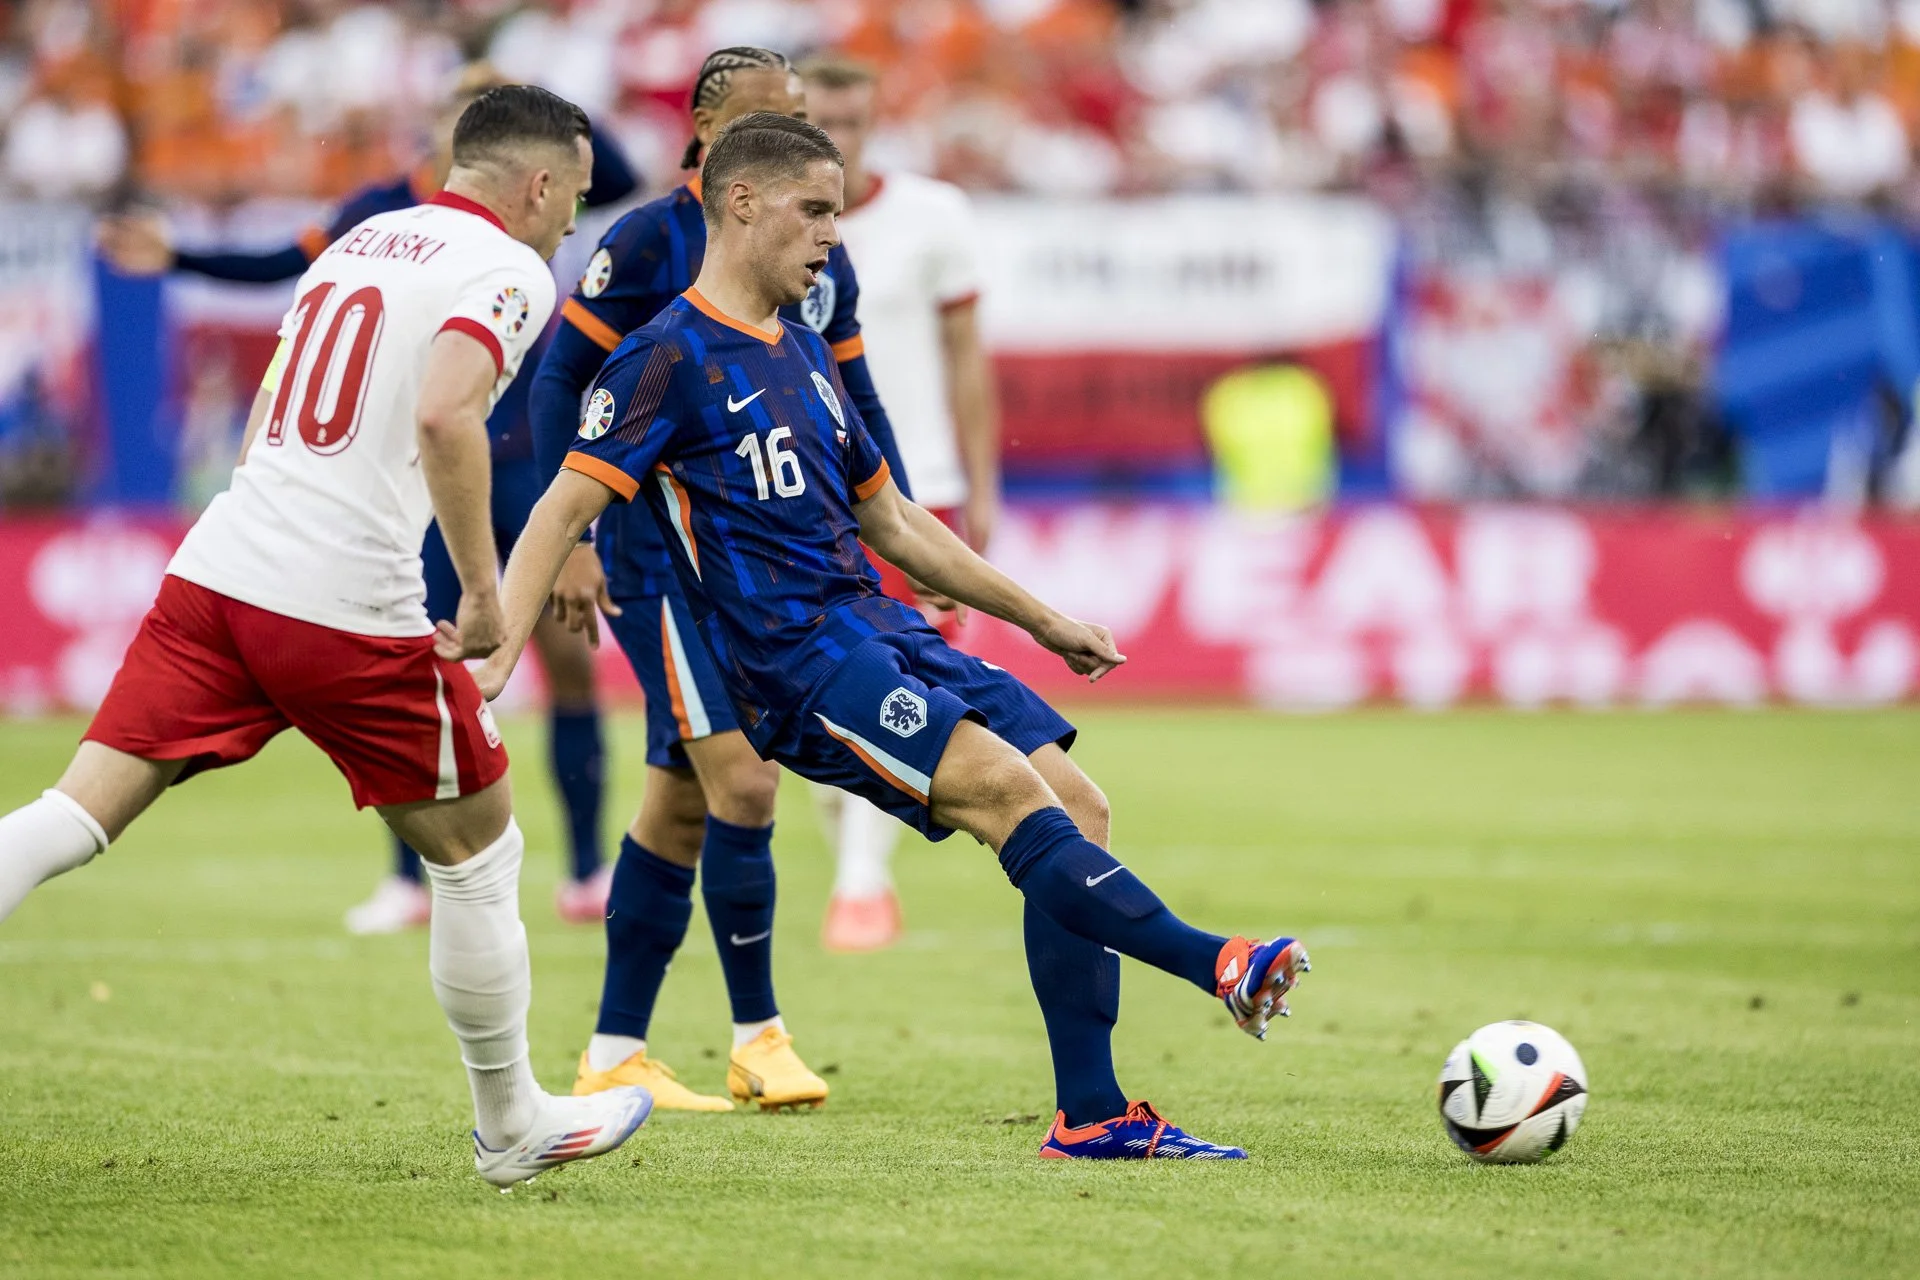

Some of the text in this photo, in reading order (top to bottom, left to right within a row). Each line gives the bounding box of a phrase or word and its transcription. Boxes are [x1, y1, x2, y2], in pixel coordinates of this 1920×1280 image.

[329, 228, 446, 265] IELIŃSKI
[267, 281, 385, 456] 10
[735, 426, 806, 501] 16
[985, 503, 1597, 640] WEAR
